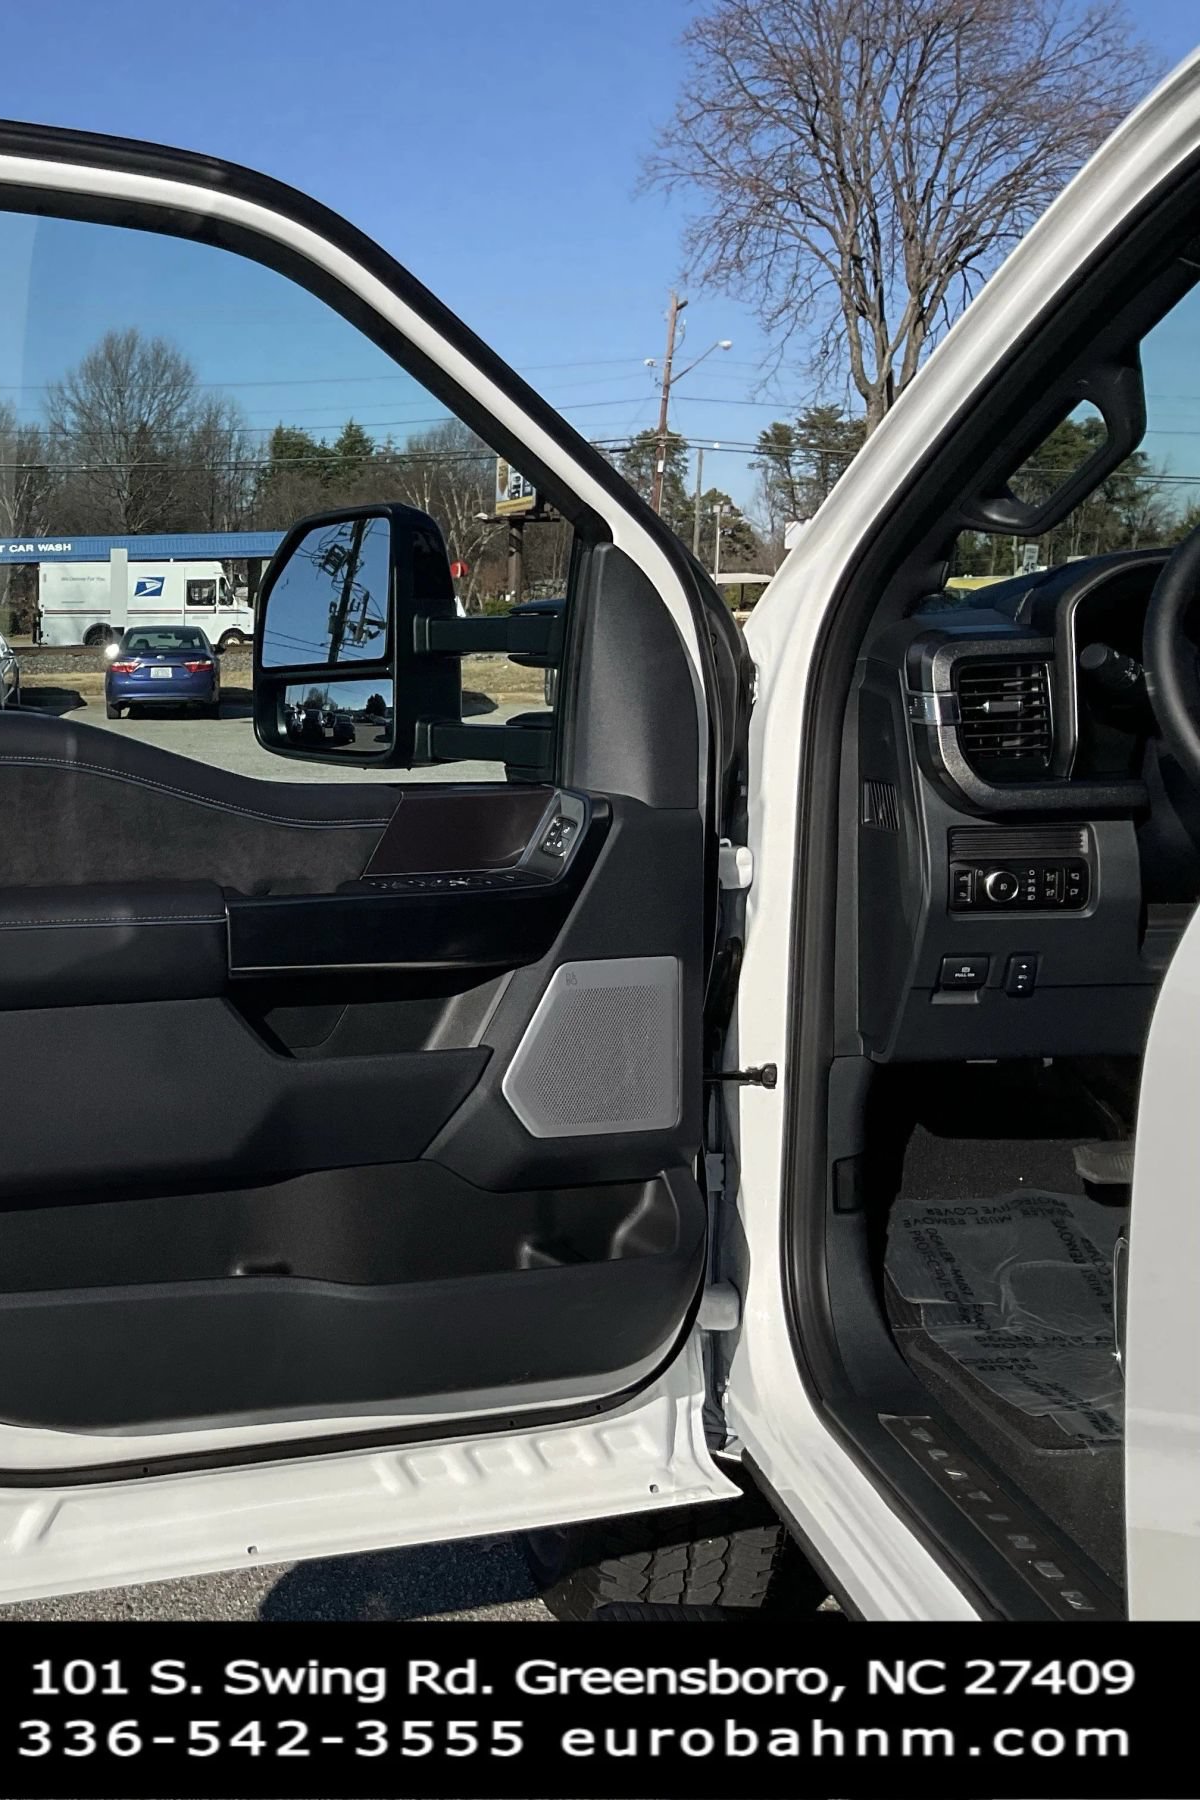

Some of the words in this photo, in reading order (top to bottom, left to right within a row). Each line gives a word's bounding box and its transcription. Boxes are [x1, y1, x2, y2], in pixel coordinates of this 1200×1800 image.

[9, 544, 34, 553] CAR
[37, 543, 72, 552] WASH
[925, 1207, 978, 1216] COVER
[903, 1216, 967, 1228] REMOVE
[975, 1214, 1012, 1225] MUST
